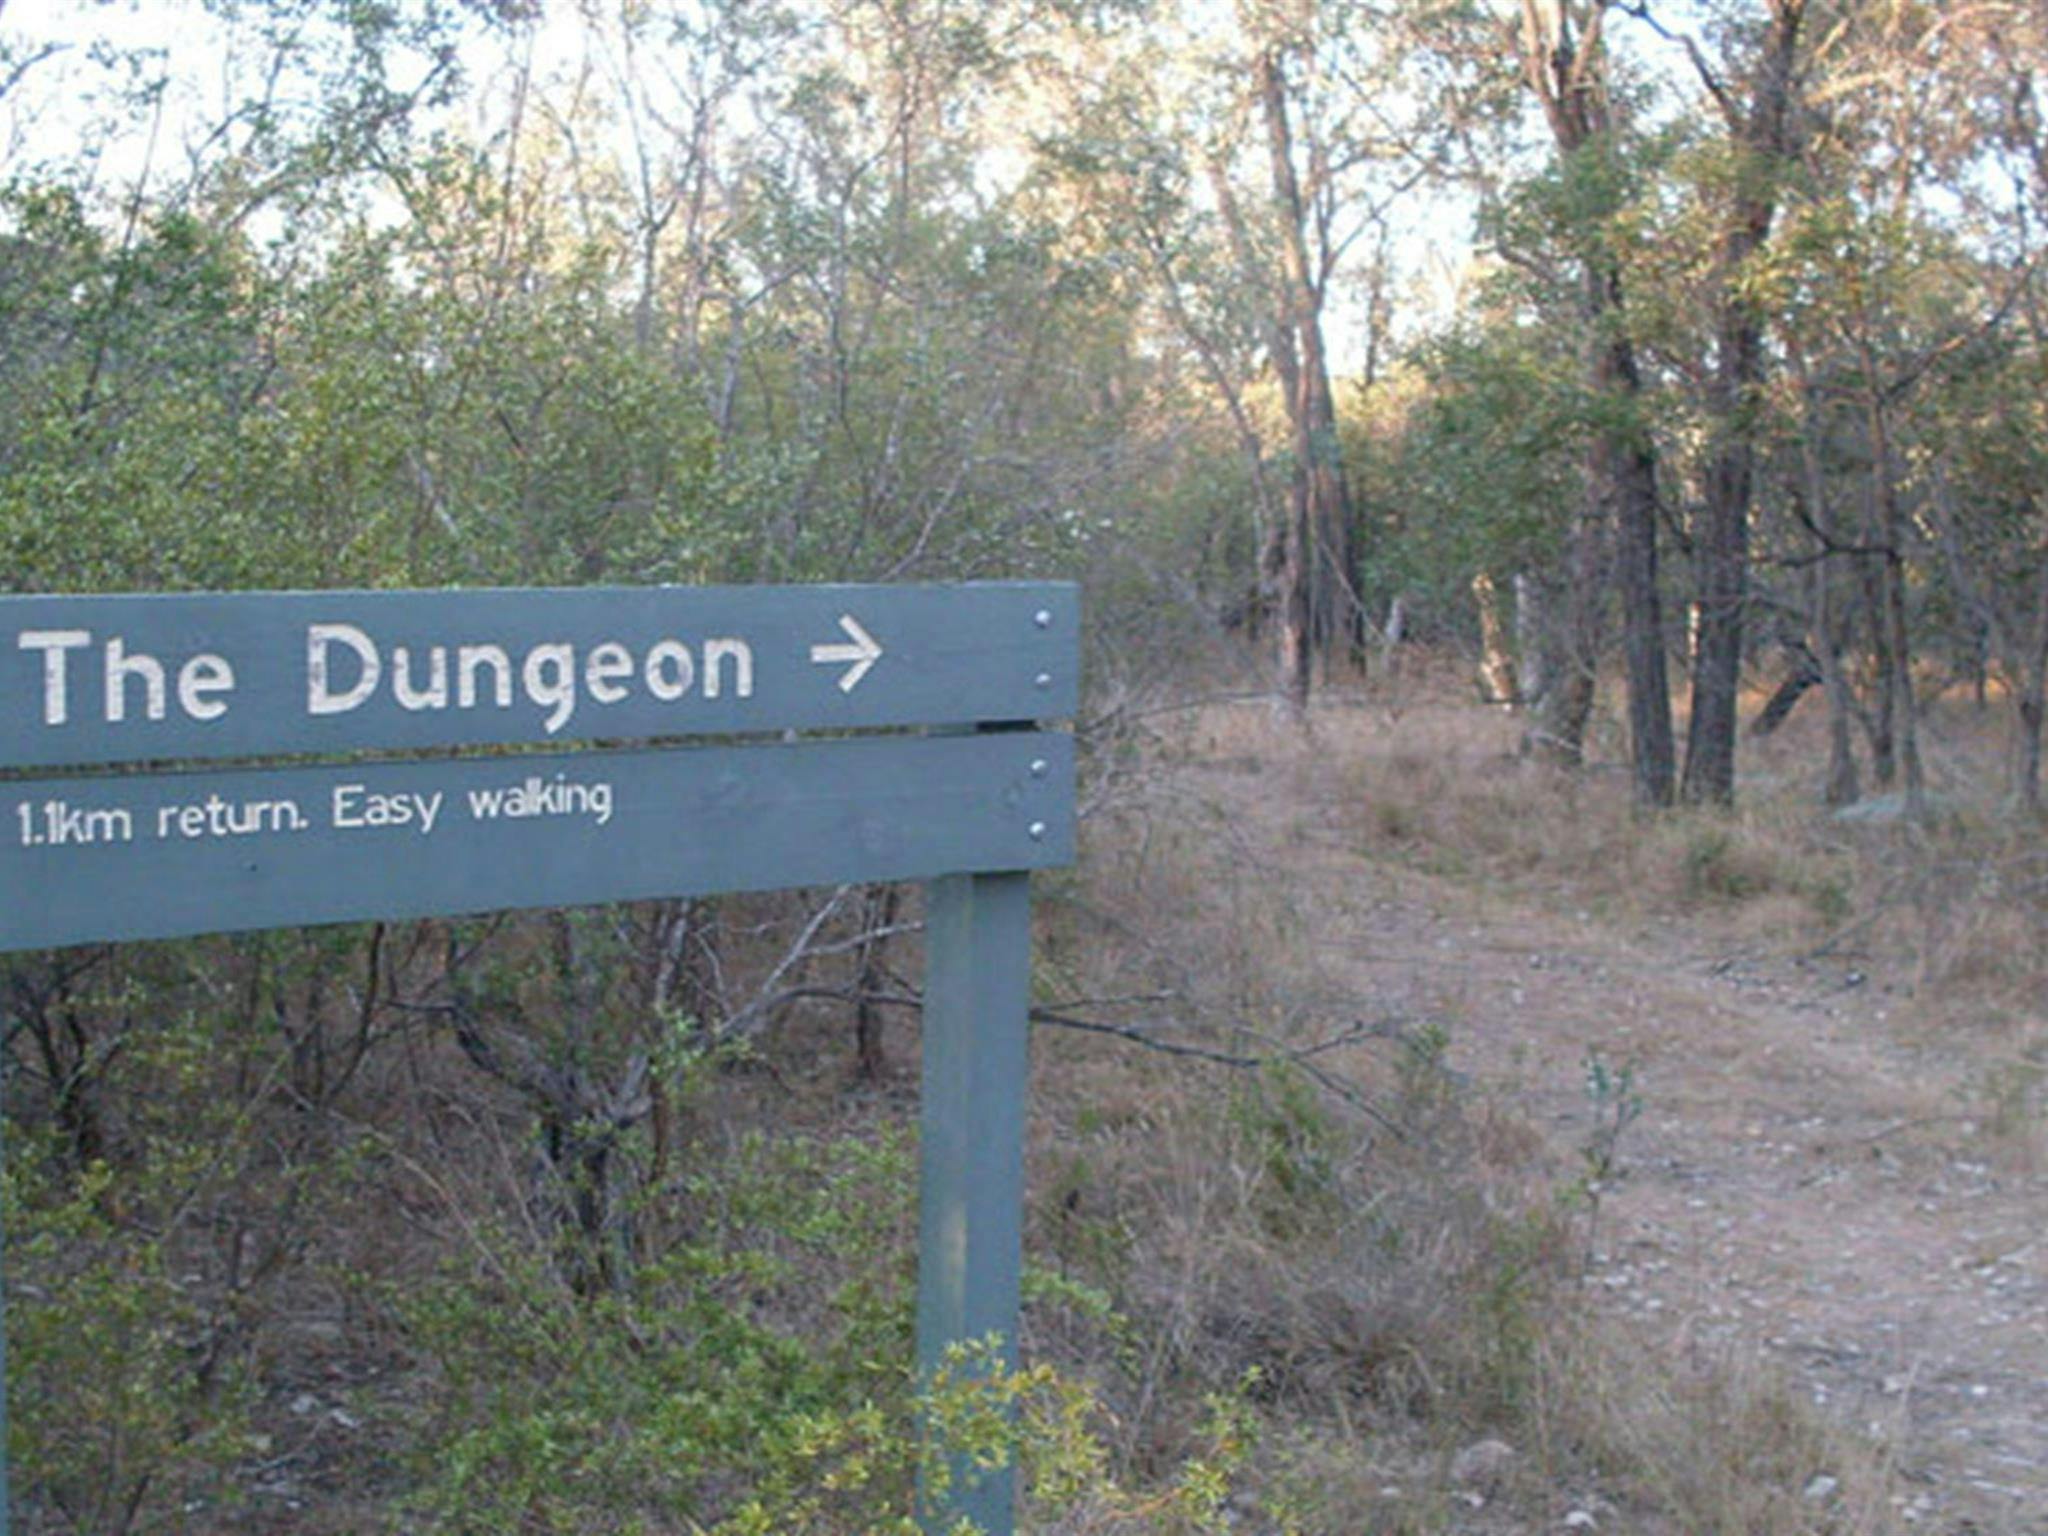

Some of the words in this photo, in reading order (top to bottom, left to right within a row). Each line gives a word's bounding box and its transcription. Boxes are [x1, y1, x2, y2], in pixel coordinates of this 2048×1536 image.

[18, 629, 236, 726] The
[307, 623, 754, 734] Dungeon
[17, 800, 132, 846] 1.1km
[157, 794, 309, 838] return.
[333, 784, 443, 833] Easy
[467, 772, 614, 825] walking
